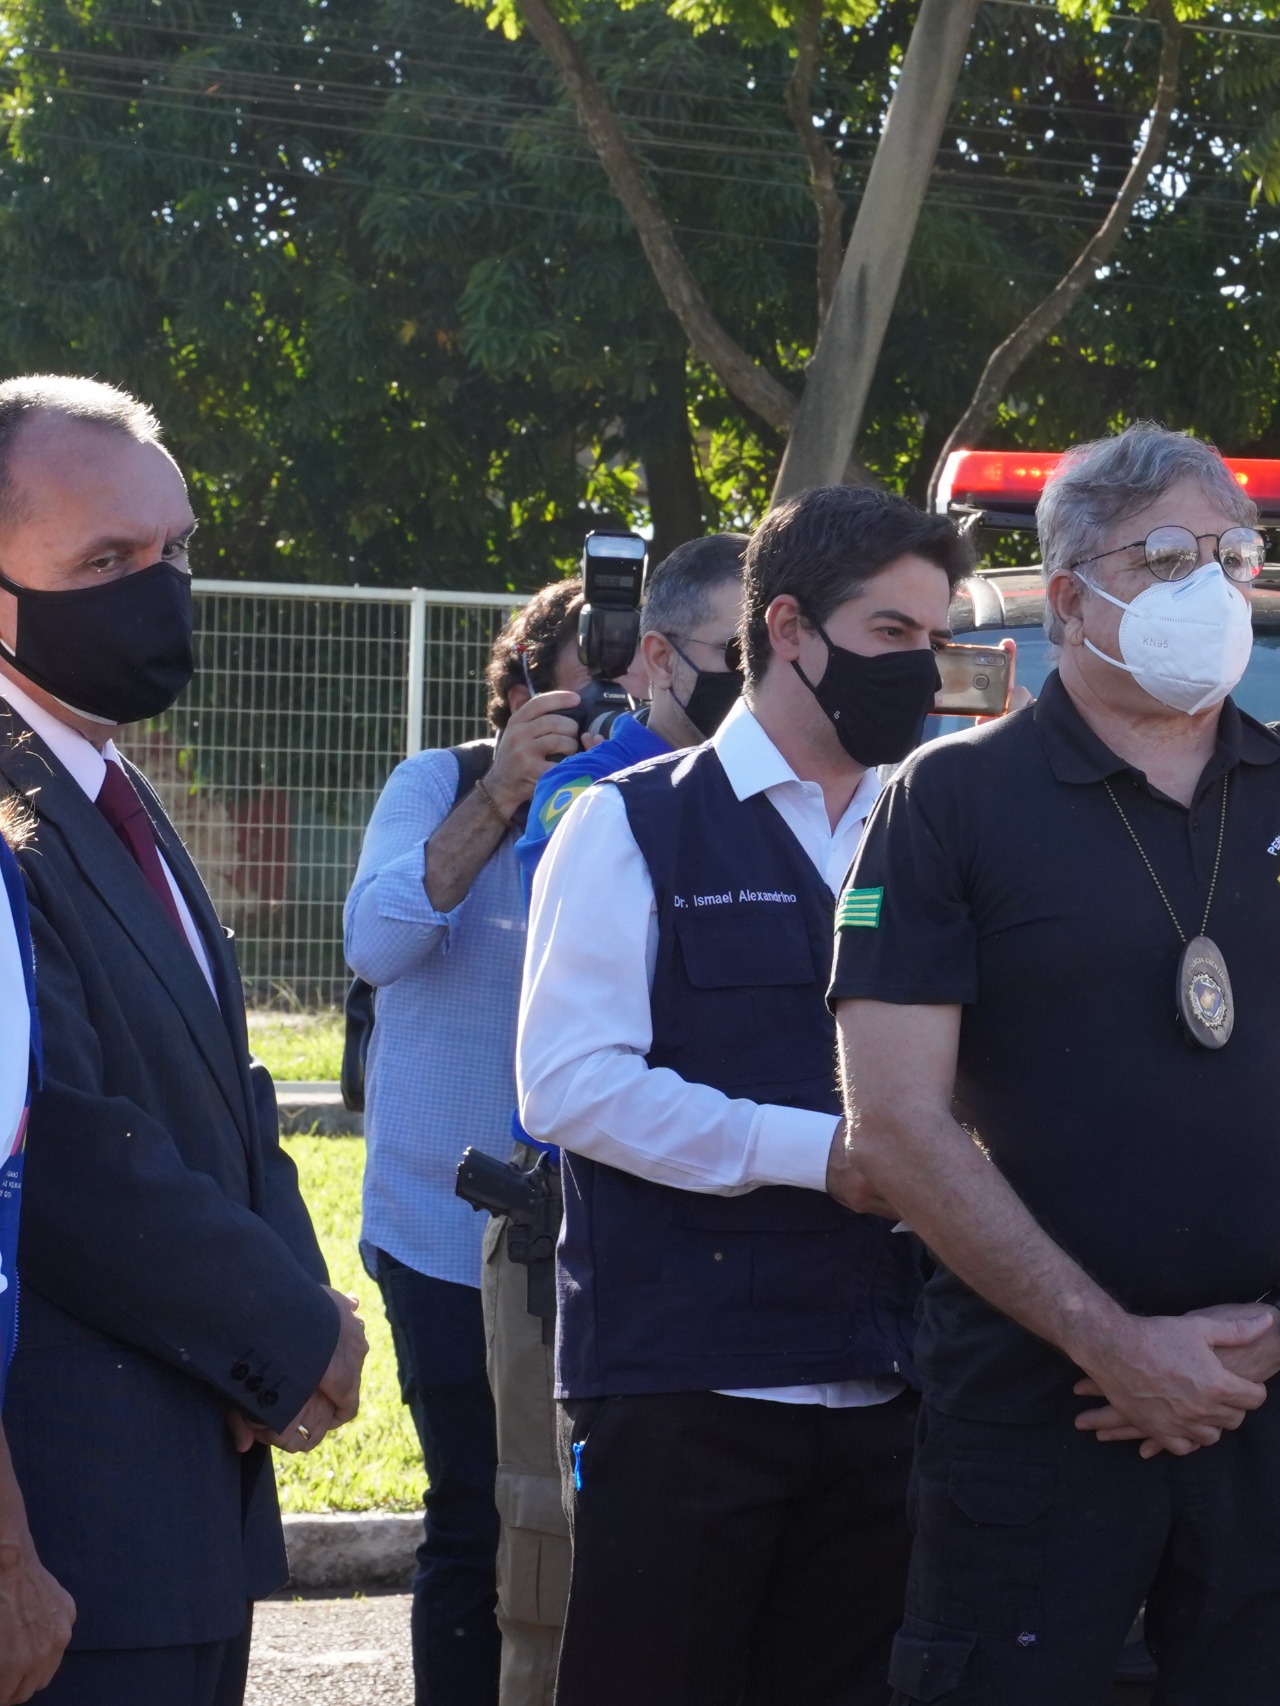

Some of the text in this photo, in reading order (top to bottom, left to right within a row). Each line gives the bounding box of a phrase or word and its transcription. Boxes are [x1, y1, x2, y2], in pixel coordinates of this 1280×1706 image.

[1142, 637, 1169, 649] KN95
[674, 889, 797, 909] Dr. Ismael Alexandrino
